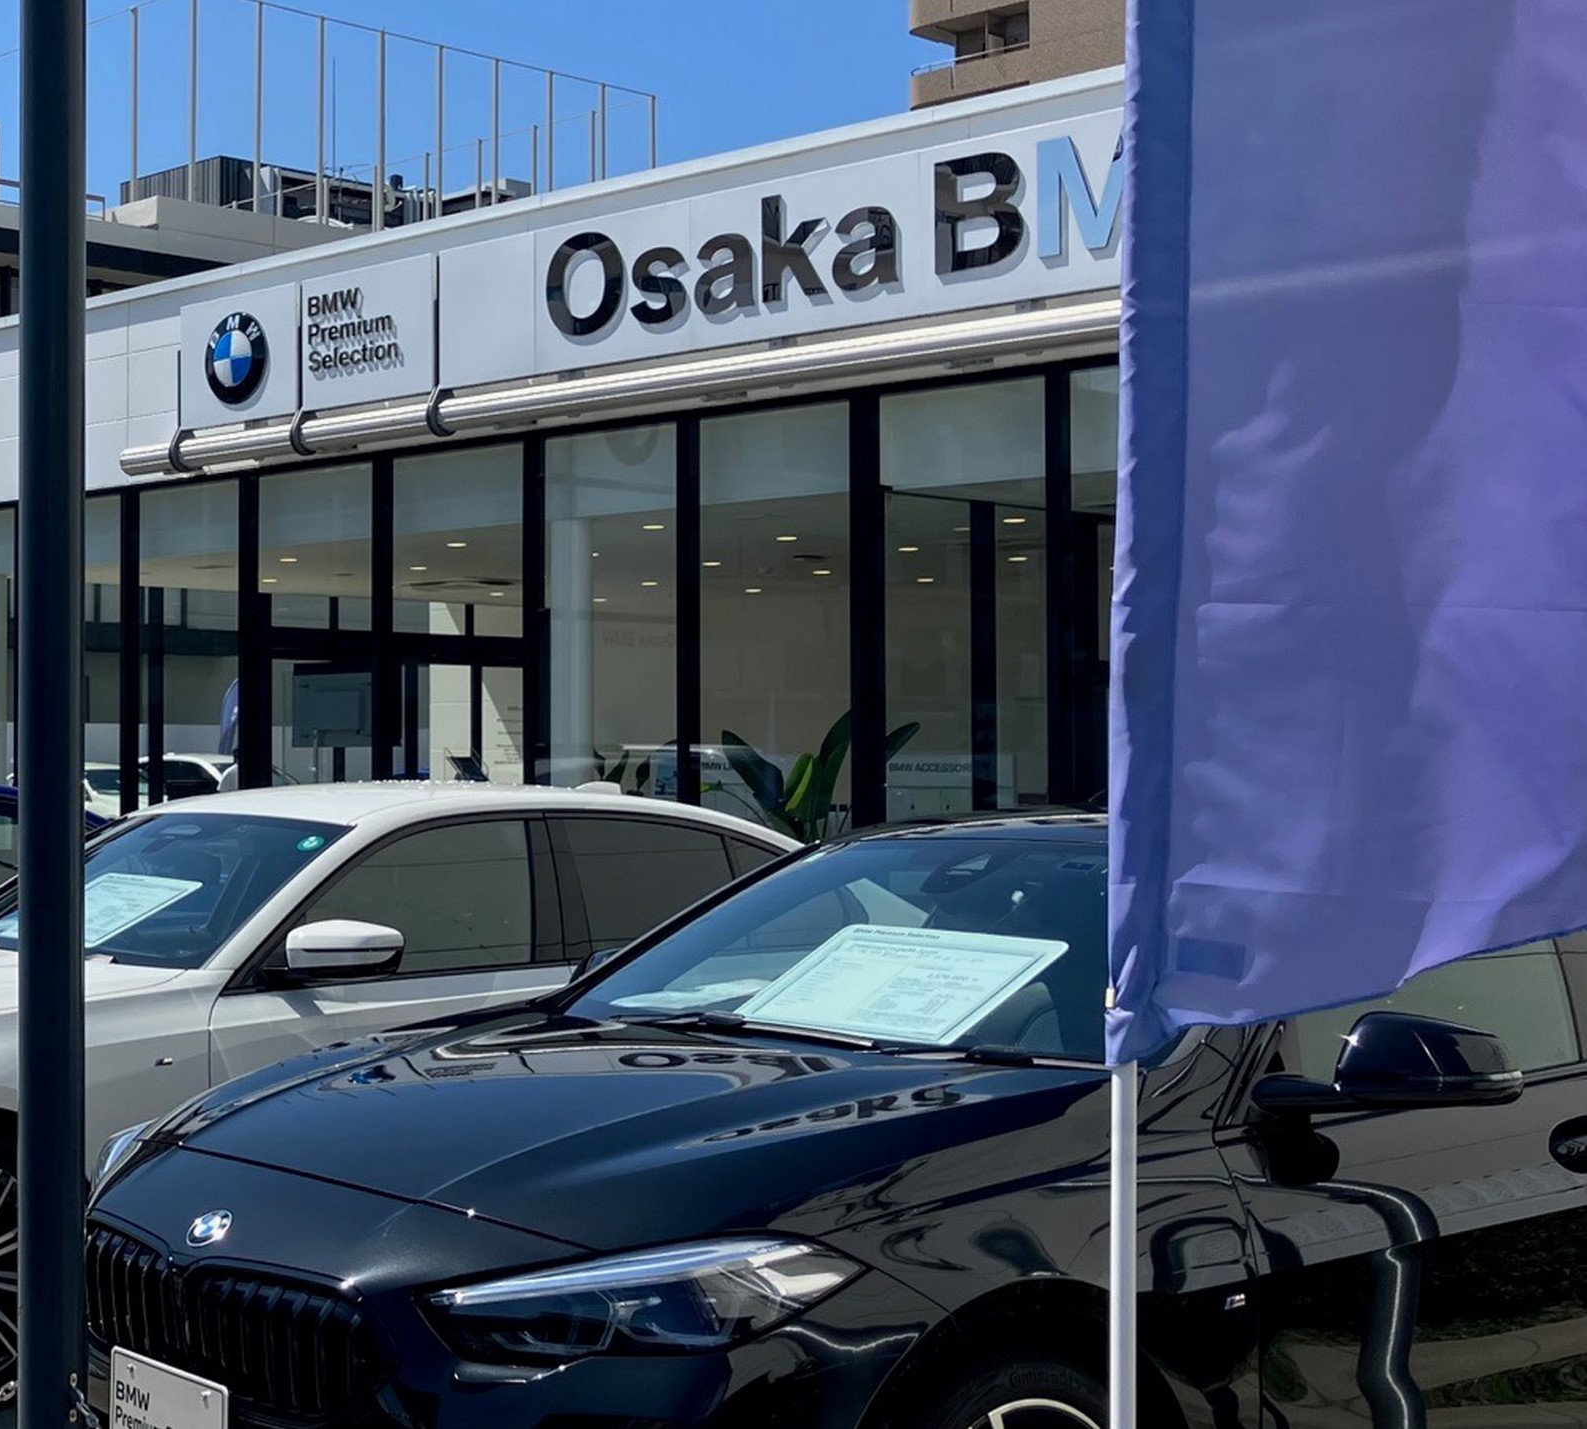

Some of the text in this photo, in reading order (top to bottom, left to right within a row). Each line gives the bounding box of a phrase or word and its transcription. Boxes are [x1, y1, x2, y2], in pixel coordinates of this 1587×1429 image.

[546, 135, 1126, 337] Osaka BM
[308, 287, 361, 318] BMW
[209, 314, 261, 349] BMW
[308, 315, 392, 345] Premium
[308, 341, 399, 372] Selection
[913, 762, 972, 773] ACCESSOR
[115, 1380, 150, 1411] BMW
